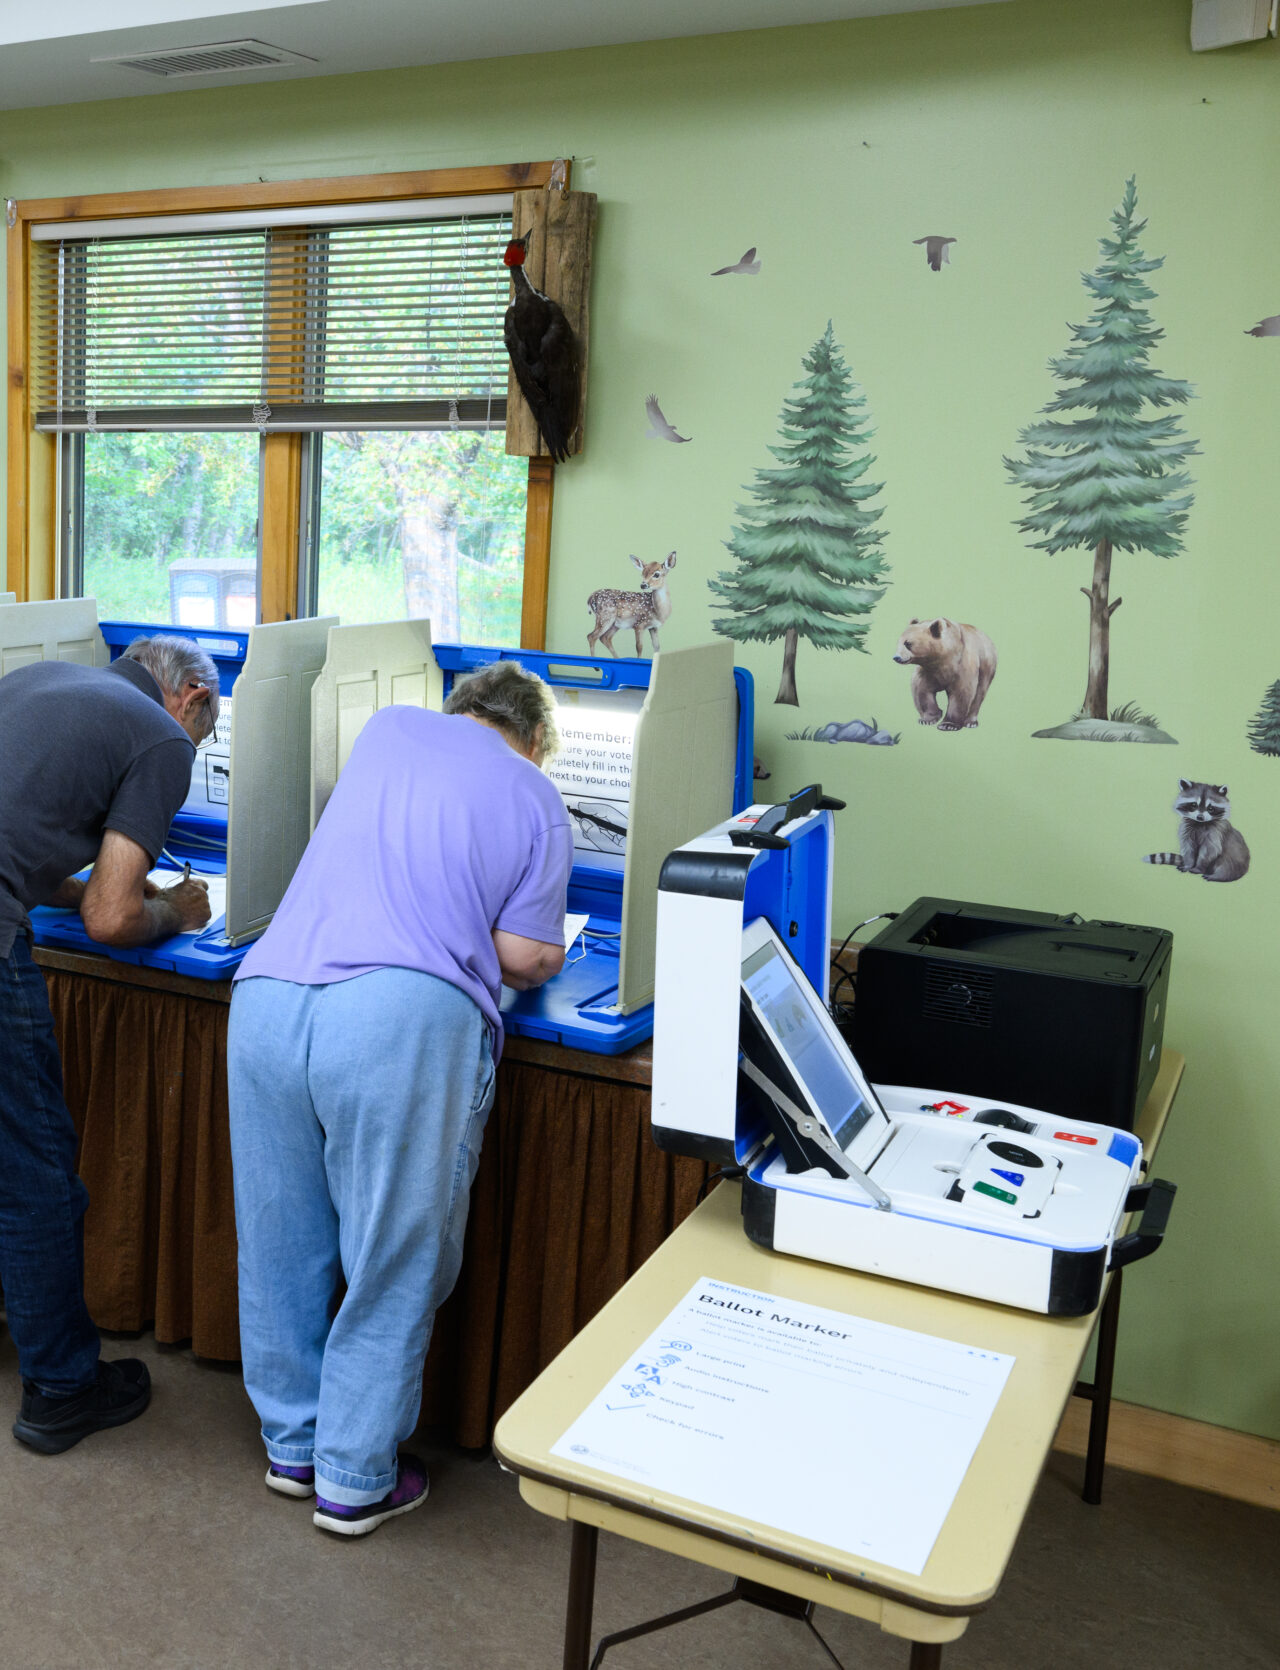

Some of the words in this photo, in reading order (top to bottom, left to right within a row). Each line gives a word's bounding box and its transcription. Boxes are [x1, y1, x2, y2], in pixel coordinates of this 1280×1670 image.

[566, 746, 583, 755] ure
[585, 748, 607, 758] your
[610, 751, 632, 761] vote
[554, 758, 590, 771] pletely
[592, 760, 605, 771] fill
[607, 763, 617, 773] in
[619, 764, 632, 775] th
[549, 771, 570, 781] next
[572, 773, 583, 782] to
[585, 776, 607, 785] your
[609, 778, 631, 788] choi
[708, 1283, 776, 1302] INSTRUCTION
[699, 1294, 766, 1317] Ballot
[771, 1313, 853, 1340] Marker
